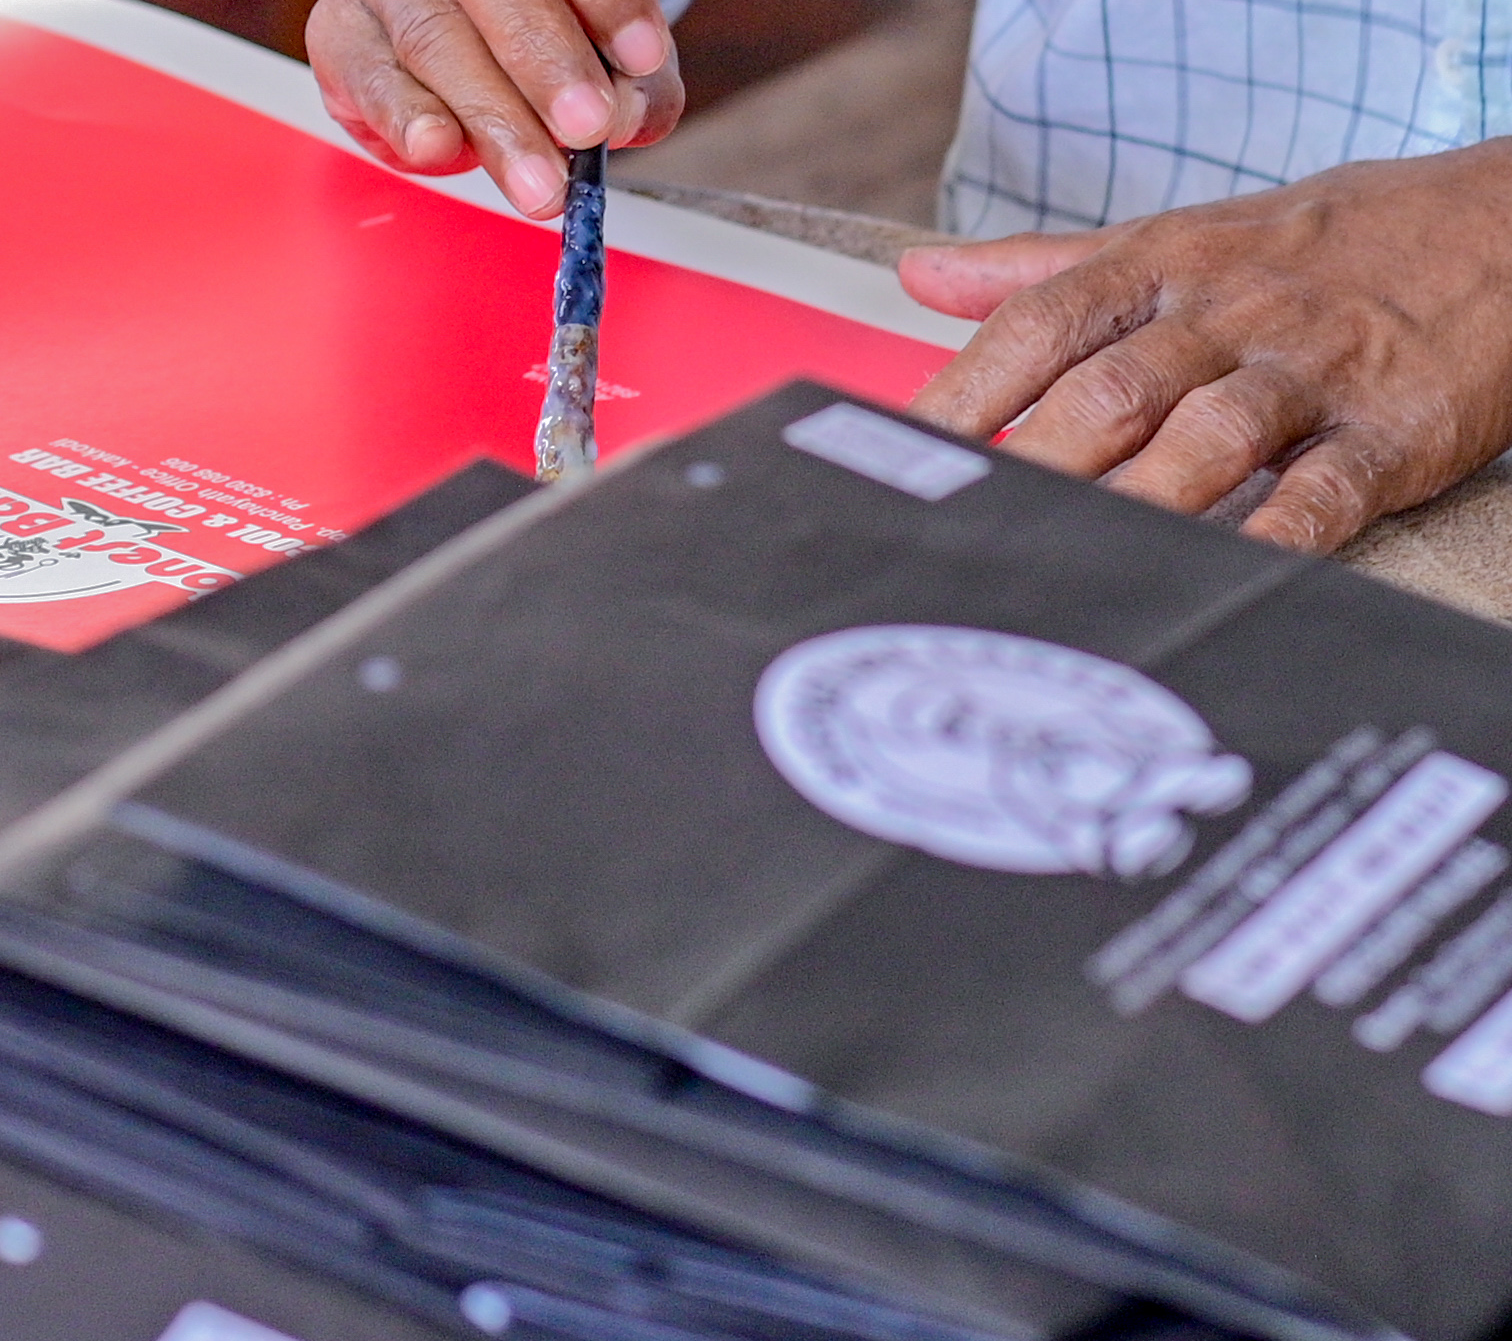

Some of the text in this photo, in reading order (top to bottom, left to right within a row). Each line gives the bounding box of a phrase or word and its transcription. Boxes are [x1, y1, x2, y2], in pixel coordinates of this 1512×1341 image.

[8, 448, 95, 479] BAR
[192, 468, 231, 484] 088
[140, 467, 200, 492] Office
[224, 479, 273, 498] 8330
[75, 472, 208, 519] COFFEE
[280, 497, 311, 511] Ph
[198, 487, 315, 531] Panchayath
[201, 512, 239, 528] &
[52, 528, 239, 592] onest
